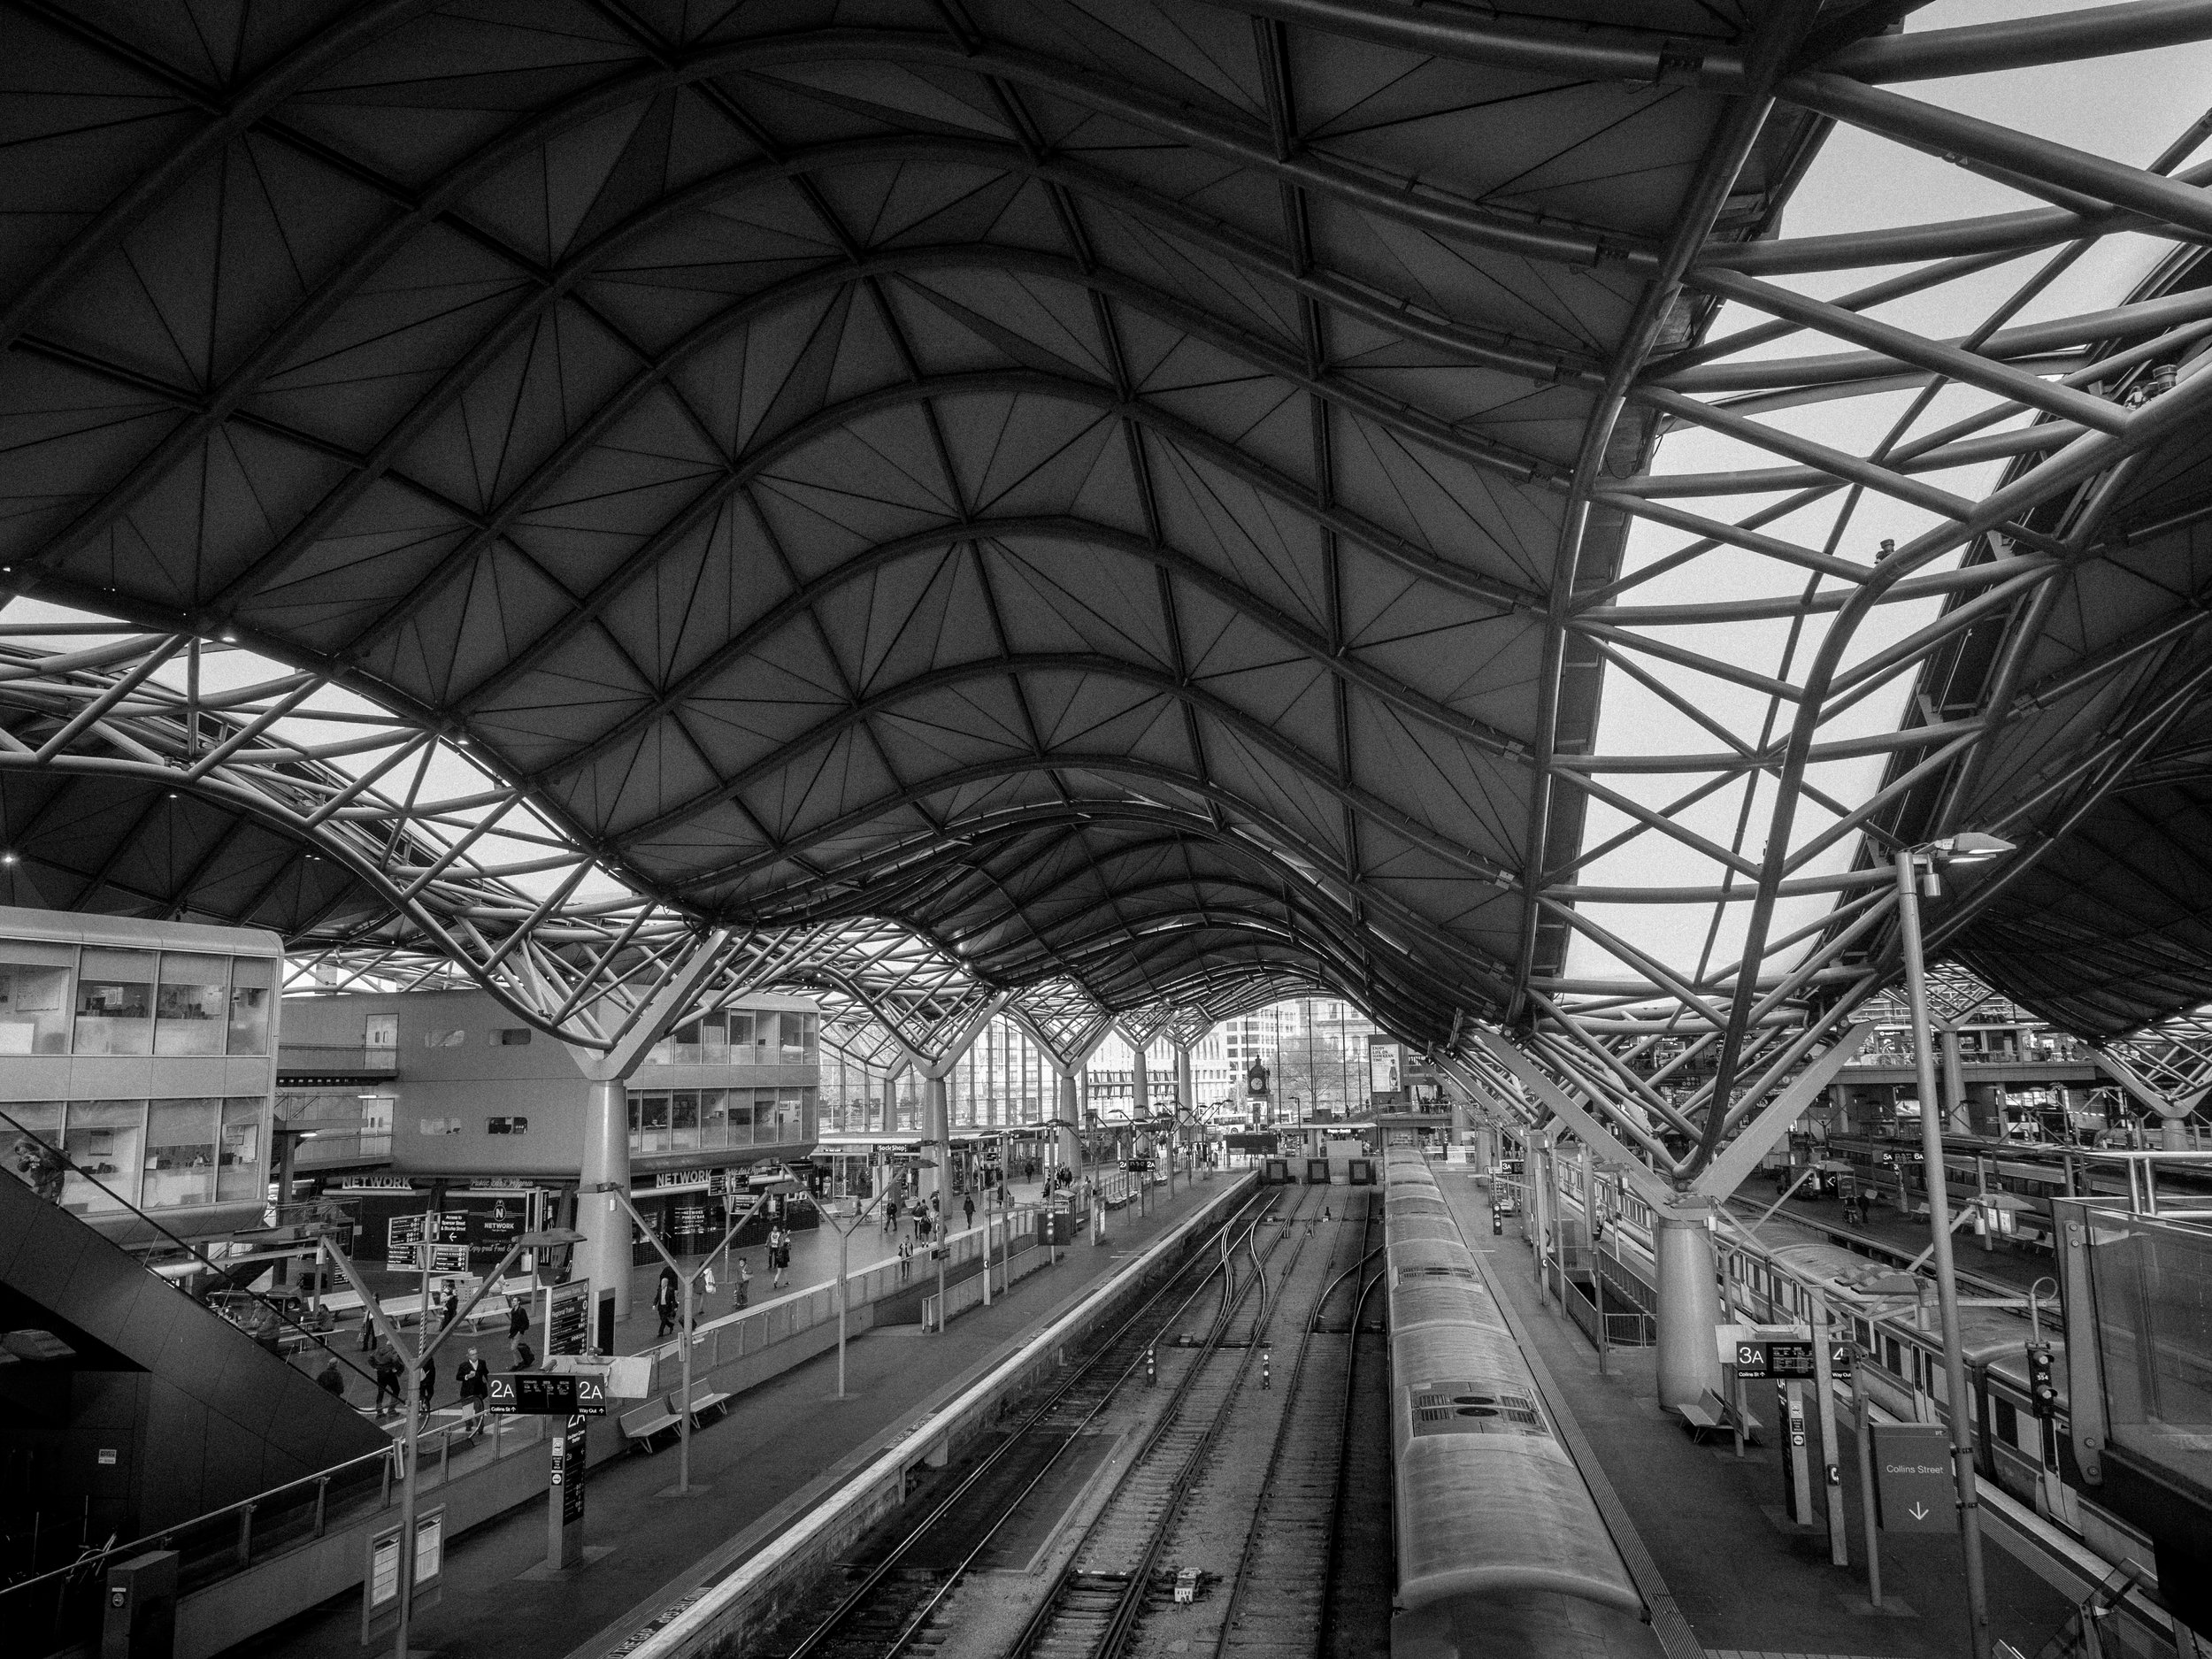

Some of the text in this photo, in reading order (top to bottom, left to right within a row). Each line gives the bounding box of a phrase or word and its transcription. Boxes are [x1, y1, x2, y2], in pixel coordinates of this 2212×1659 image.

[342, 1176, 411, 1188] NETWORK
[656, 1170, 712, 1188] NETWORK
[1739, 1347, 1764, 1364] 3A
[491, 1380, 514, 1397] 2A
[580, 1381, 603, 1399] 2A
[1886, 1464, 1944, 1474] Collins Street
